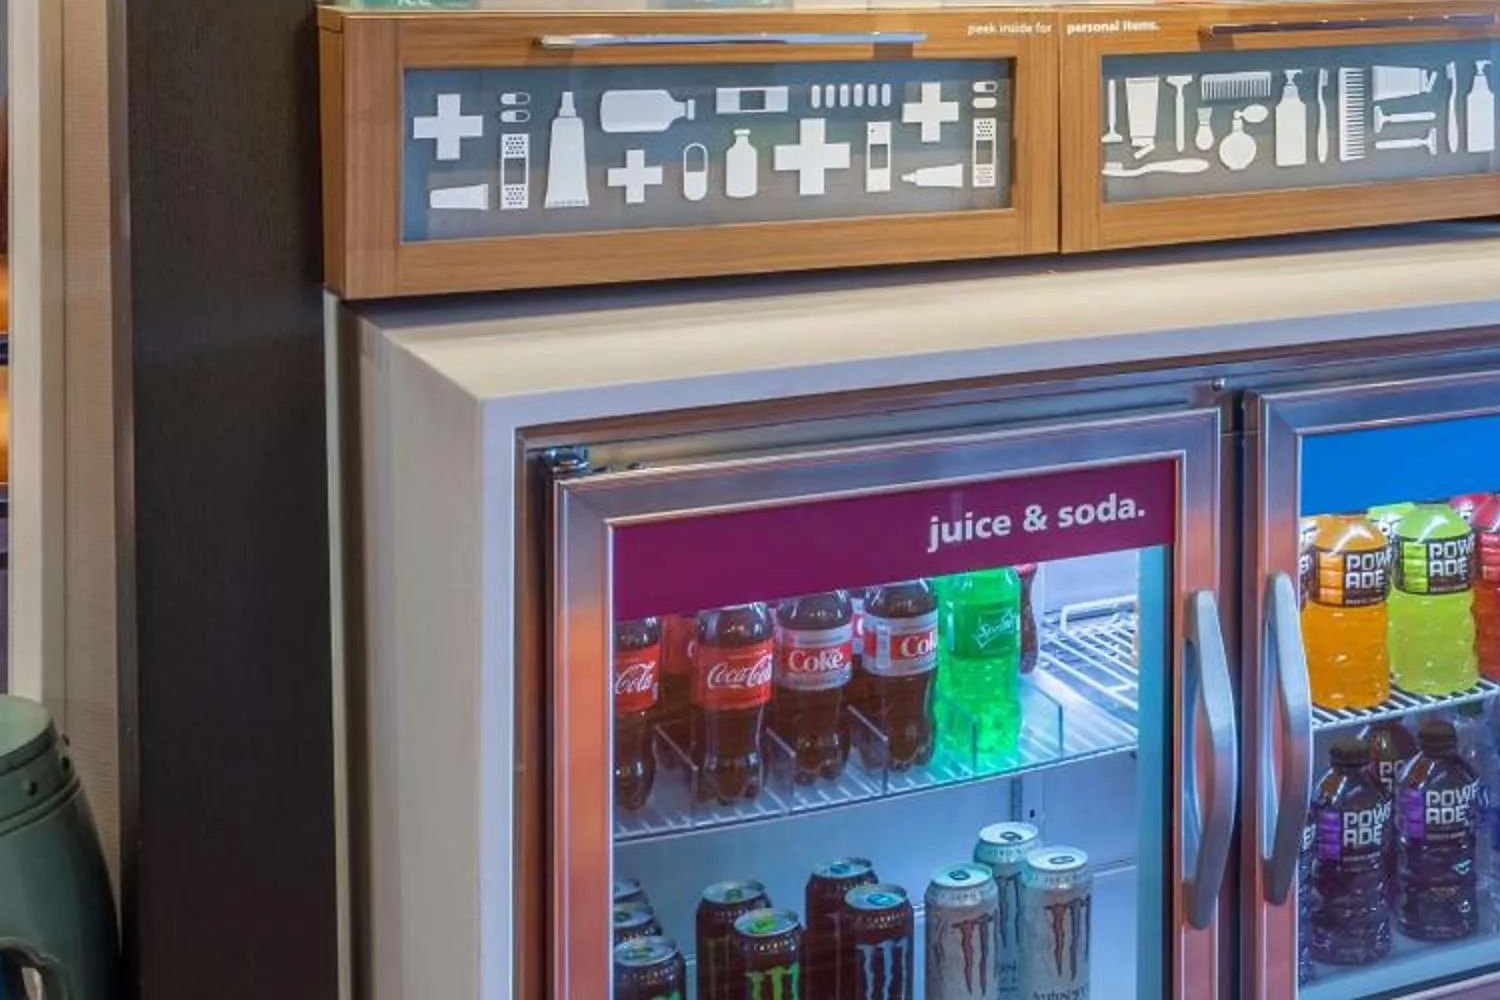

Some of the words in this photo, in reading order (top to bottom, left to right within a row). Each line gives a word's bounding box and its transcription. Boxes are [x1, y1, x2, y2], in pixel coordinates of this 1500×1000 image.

[967, 24, 994, 36] peek
[1000, 22, 1032, 34] inside
[1035, 22, 1052, 34] for
[1067, 20, 1120, 35] personal
[927, 511, 1012, 552] juice
[1023, 504, 1049, 533] &
[1057, 493, 1146, 530] soda.
[1430, 556, 1468, 577] ADE
[1346, 569, 1385, 589] ADE
[788, 646, 844, 673] Coke
[1426, 803, 1470, 825] ADE
[1343, 824, 1383, 849] ADE
